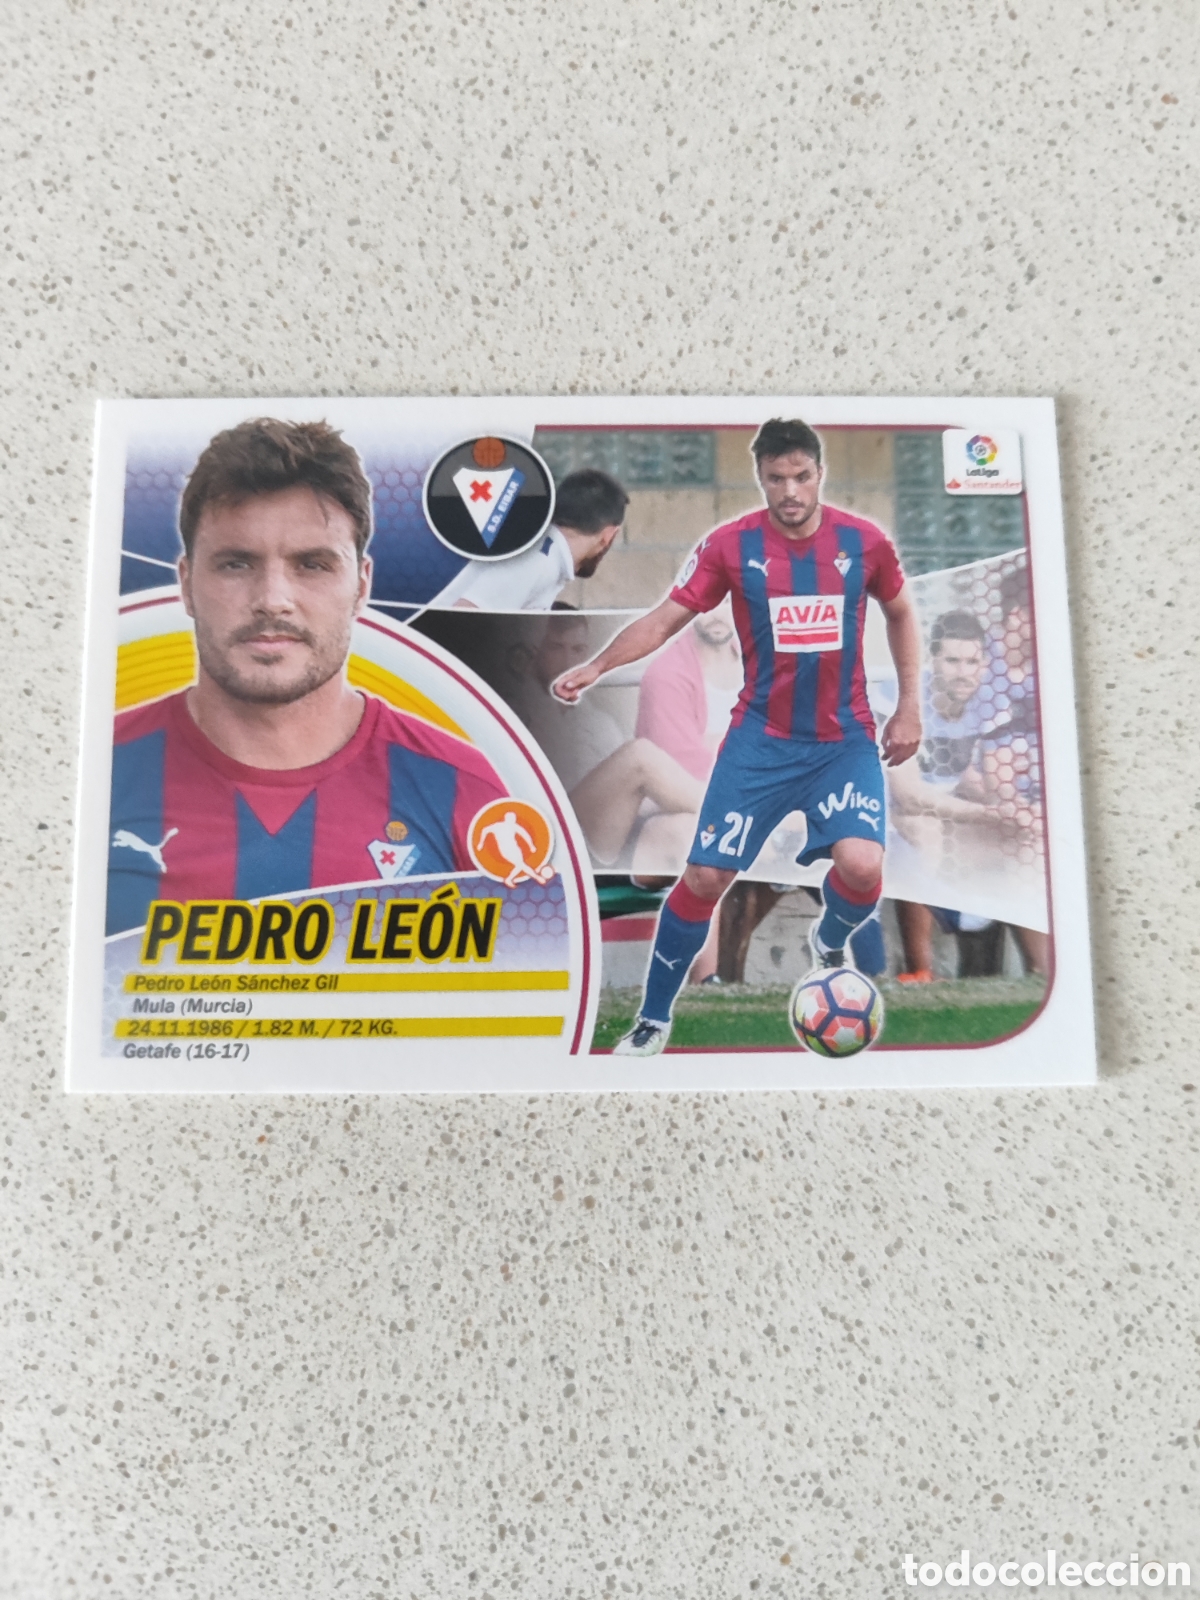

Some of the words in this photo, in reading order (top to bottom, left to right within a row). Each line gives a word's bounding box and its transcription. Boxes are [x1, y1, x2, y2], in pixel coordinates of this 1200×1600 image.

[501, 480, 520, 513] EIBAR
[776, 600, 838, 625] AVÍA
[818, 782, 881, 820] Wiko
[718, 811, 753, 858] 21
[140, 900, 333, 964] PEDRO
[347, 883, 501, 963] LEÓN
[133, 975, 185, 991] Pedro
[190, 974, 231, 991] León
[236, 974, 310, 991] Sánchez
[315, 974, 339, 990] Gil
[132, 998, 175, 1013] Mula
[180, 998, 253, 1016] (Murcia)
[127, 1020, 233, 1036] 24.11.1986
[235, 1020, 248, 1038] /
[252, 1020, 293, 1036] 1.82
[299, 1020, 319, 1036] M.
[322, 1020, 335, 1038] /
[340, 1020, 363, 1035] 72
[368, 1019, 398, 1035] KG.
[123, 1043, 181, 1059] Getafe
[186, 1043, 250, 1062] (16-17)
